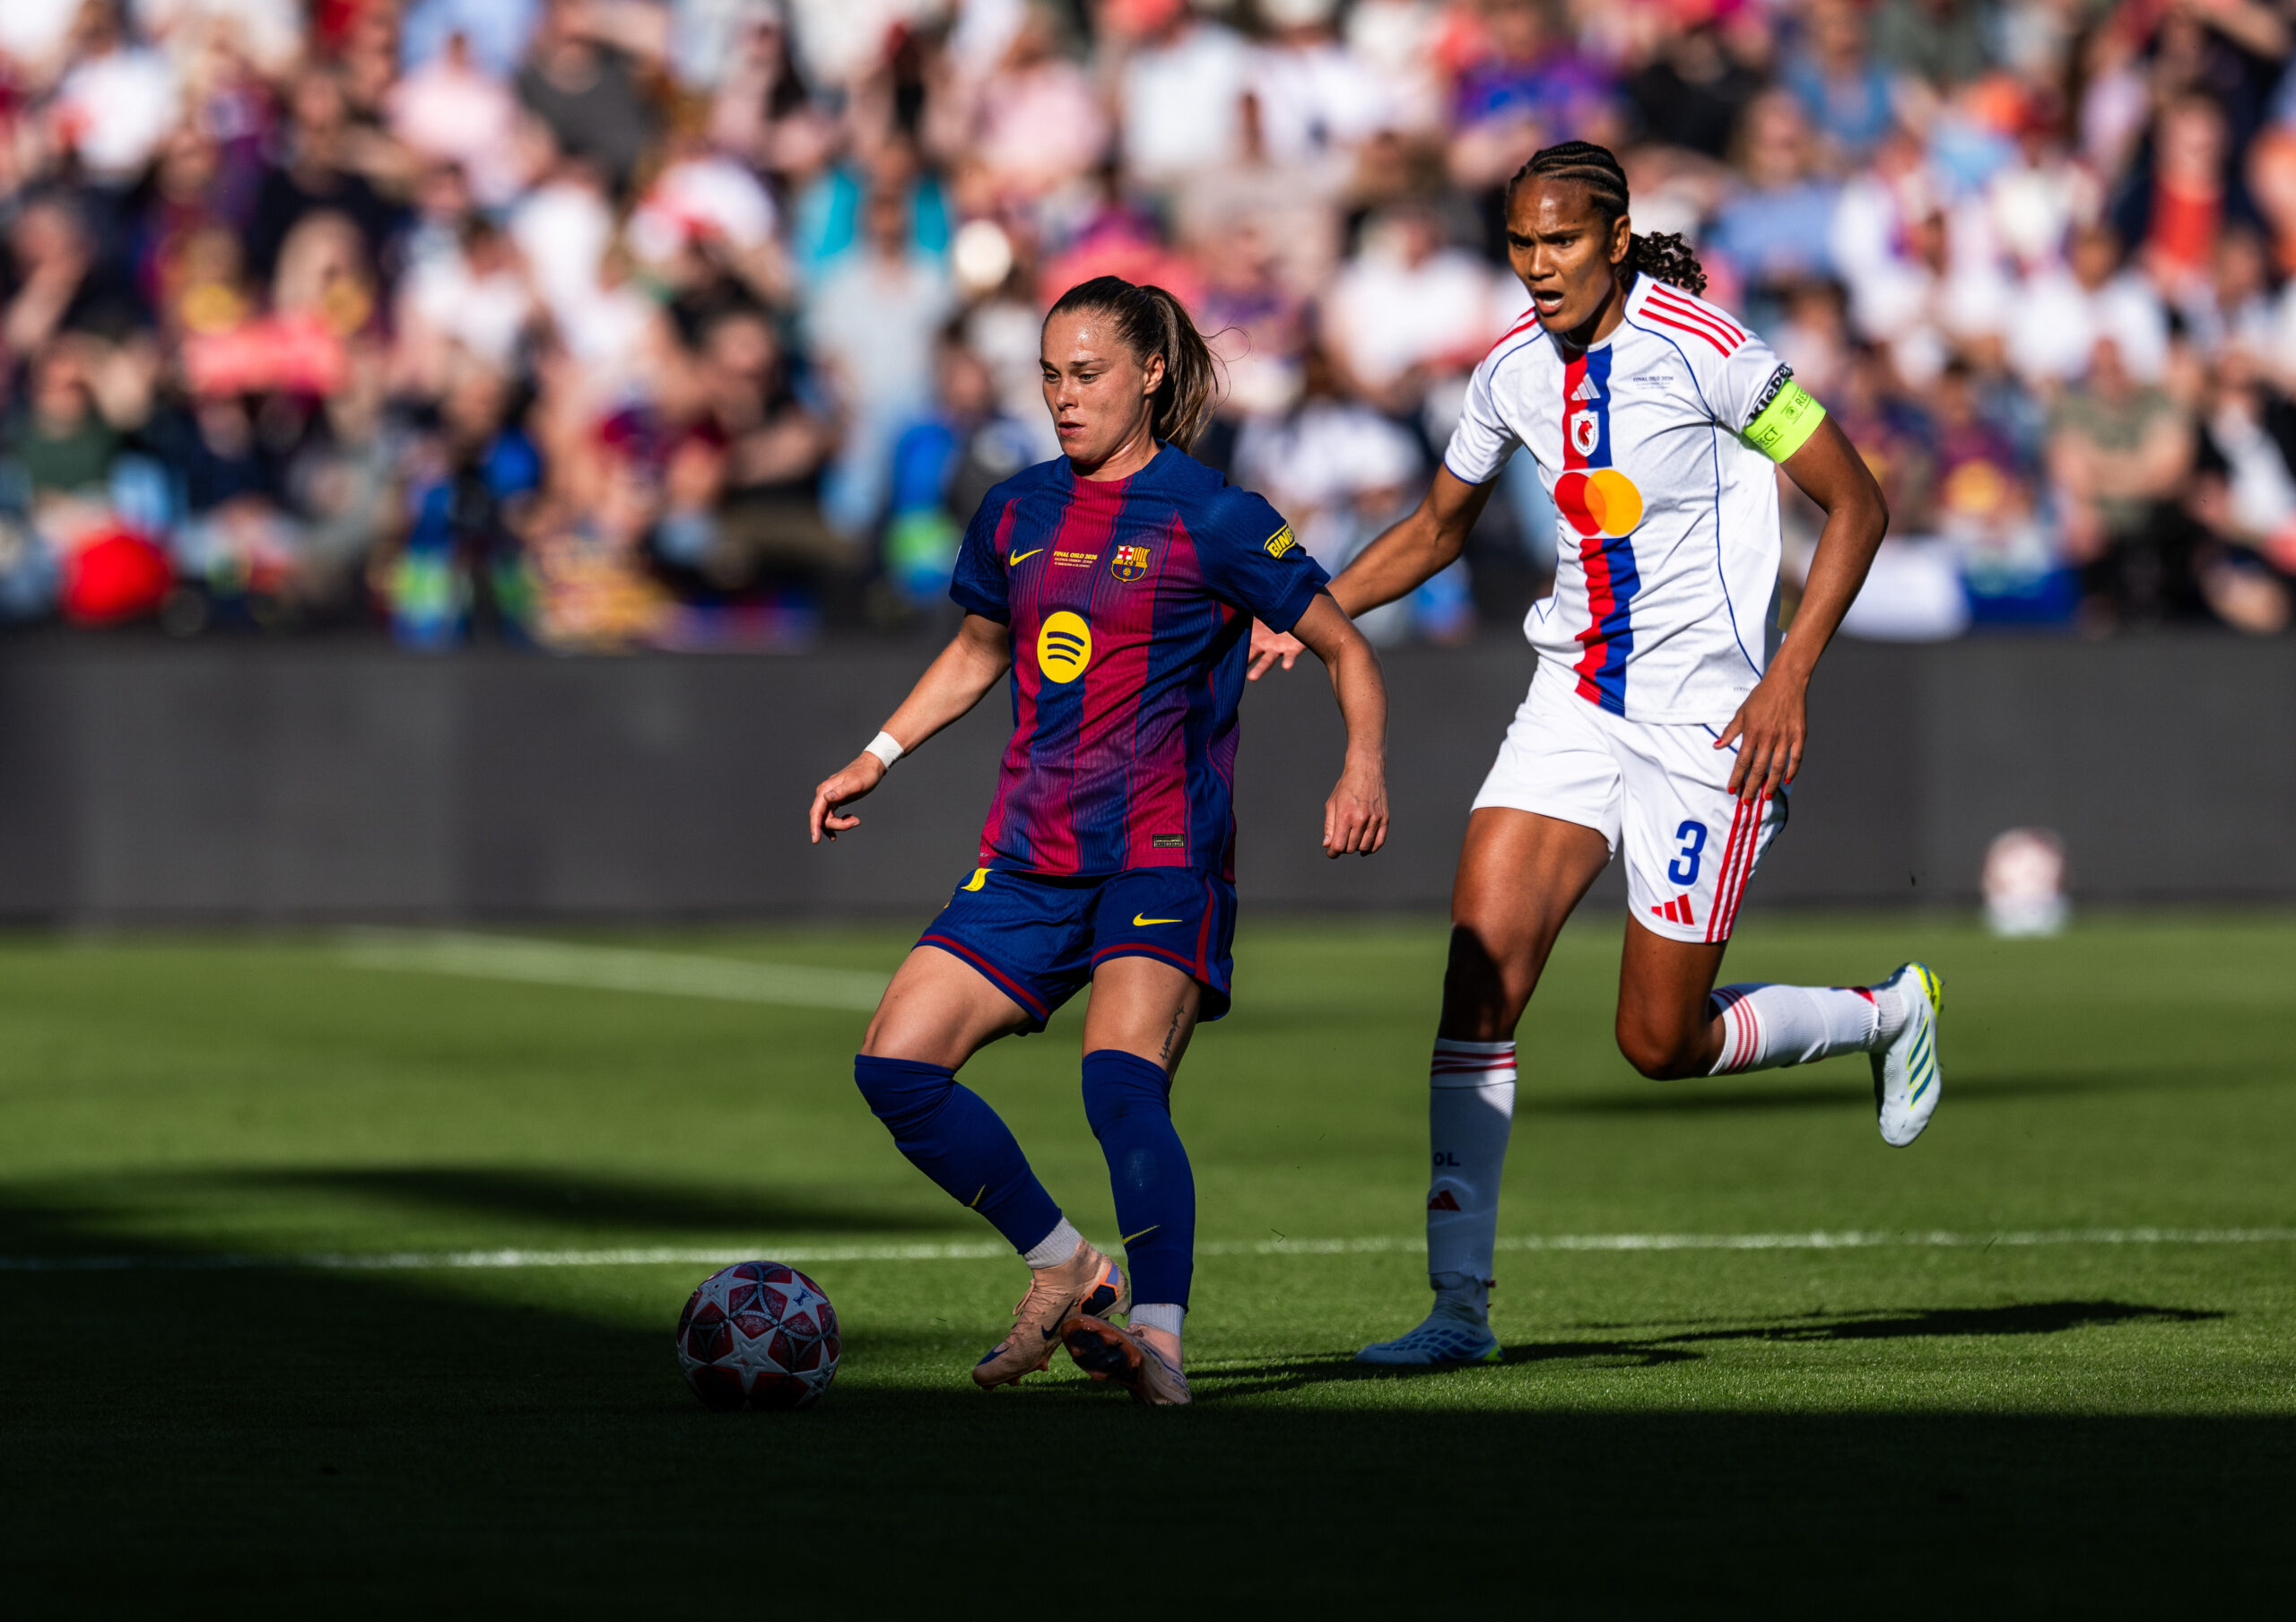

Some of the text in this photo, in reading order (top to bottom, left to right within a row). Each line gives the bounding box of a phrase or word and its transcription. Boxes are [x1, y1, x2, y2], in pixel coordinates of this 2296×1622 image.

[1748, 363, 1791, 421] Kleber
[1668, 820, 1708, 886] 3
[1433, 1151, 1461, 1167] OL
